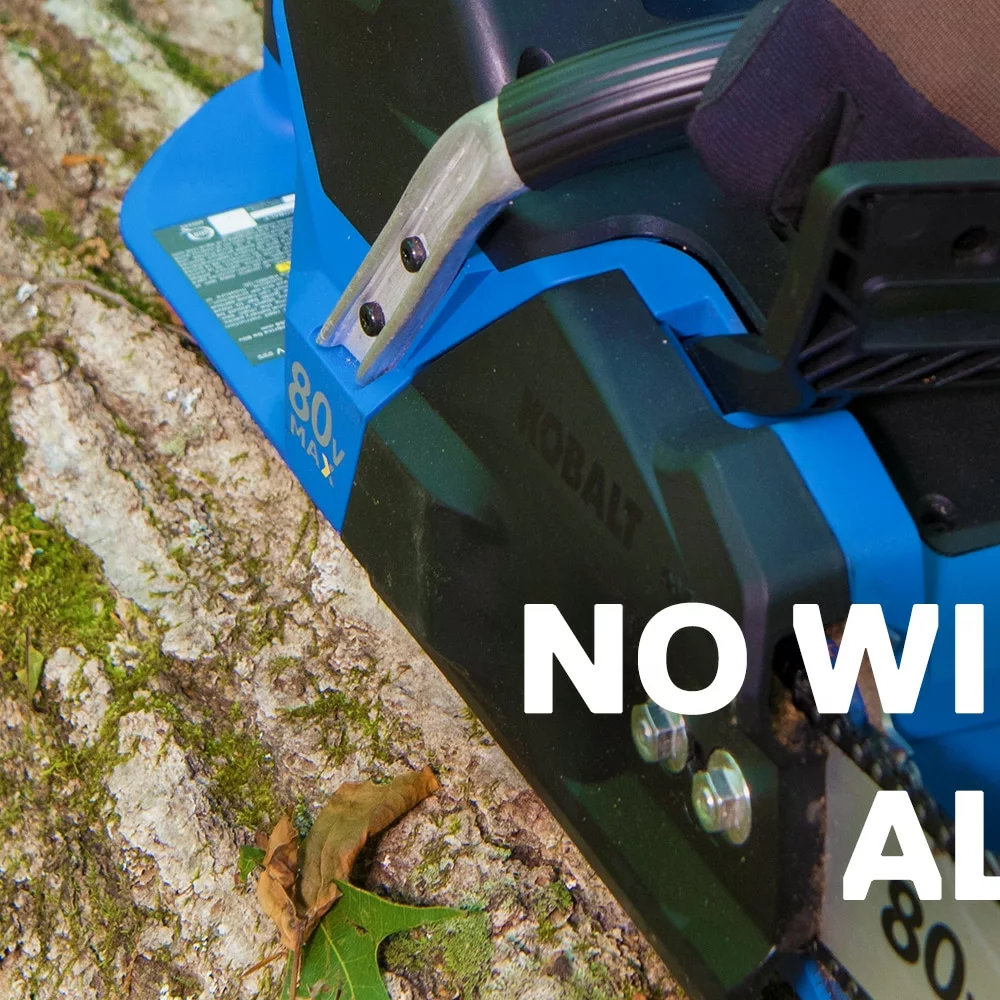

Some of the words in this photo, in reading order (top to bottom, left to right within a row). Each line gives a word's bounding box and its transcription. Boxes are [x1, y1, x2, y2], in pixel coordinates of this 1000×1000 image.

[290, 414, 334, 488] MAX
[517, 385, 644, 551] KOBALT
[881, 880, 974, 1000] 80
